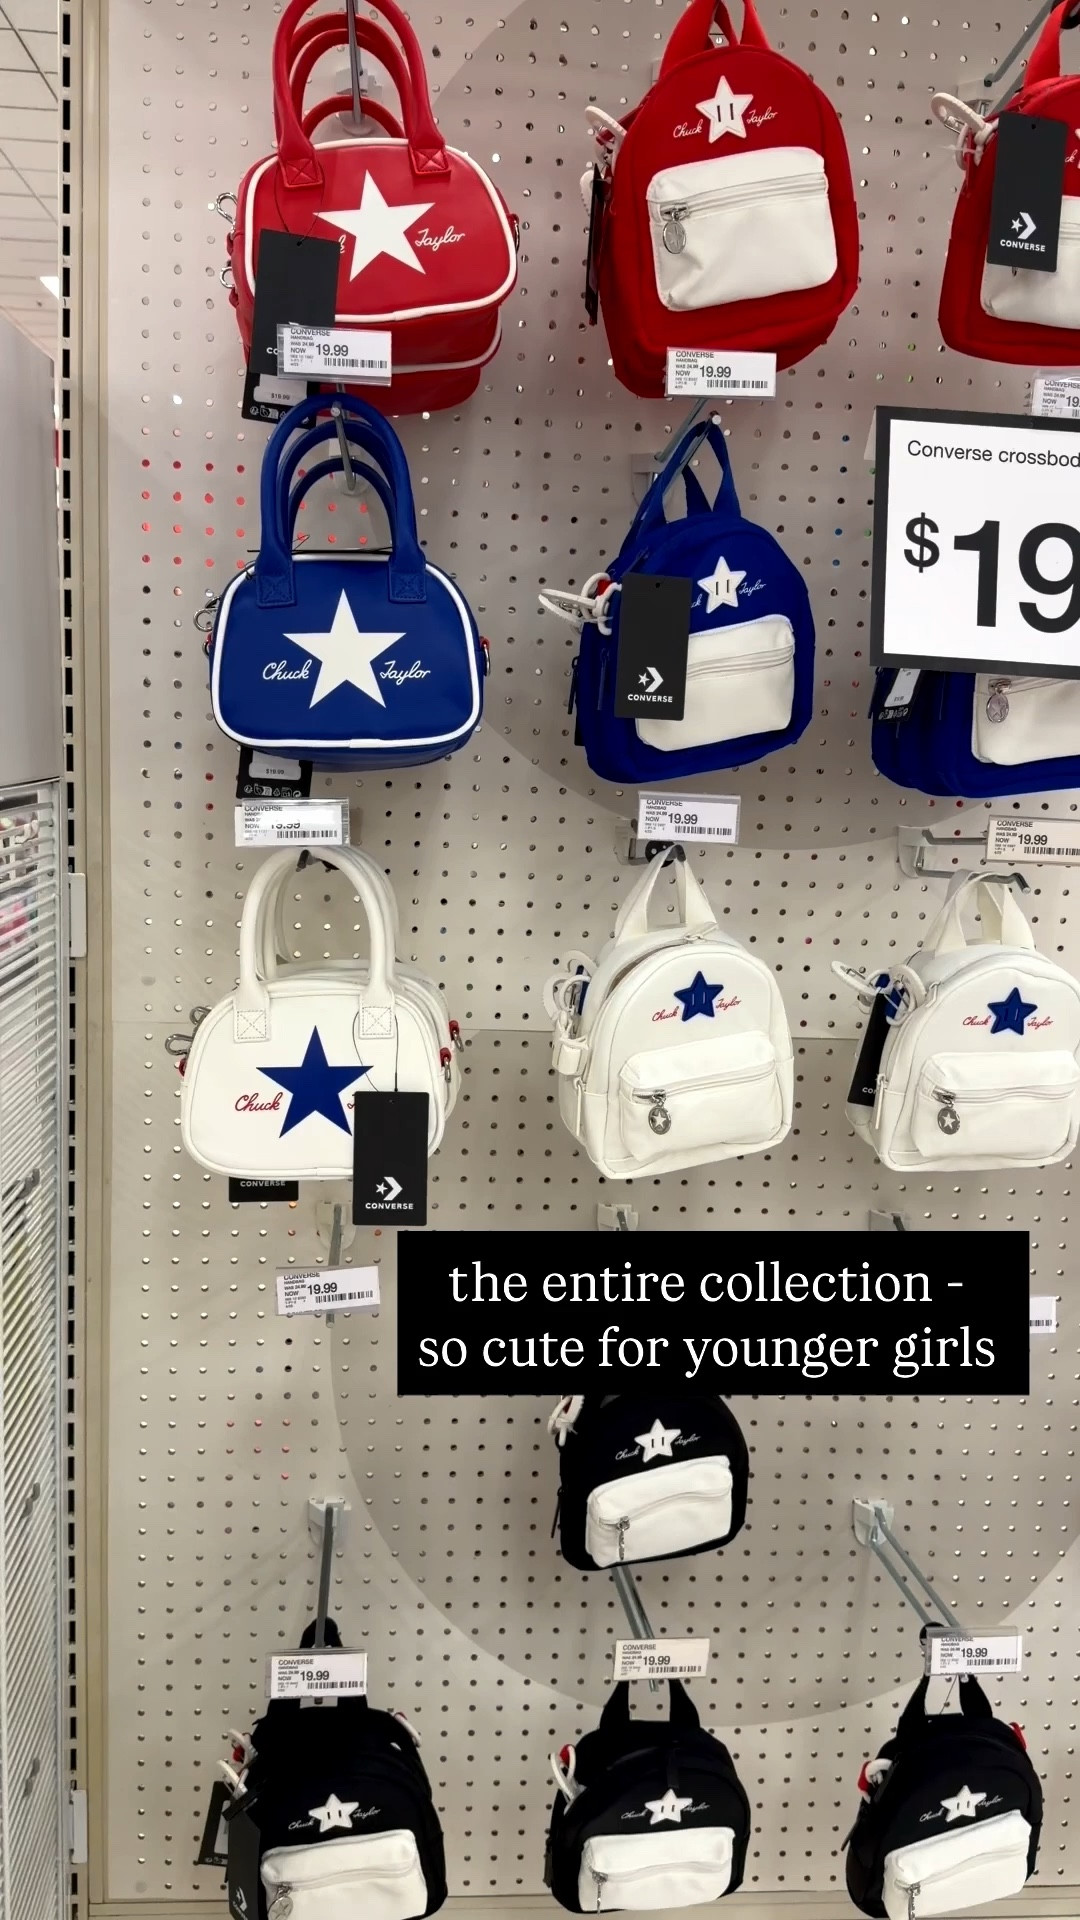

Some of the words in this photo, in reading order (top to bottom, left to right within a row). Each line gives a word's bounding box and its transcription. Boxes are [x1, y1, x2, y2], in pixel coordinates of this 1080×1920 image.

[673, 119, 704, 138] Chuck
[747, 106, 778, 127] Taylor
[415, 225, 465, 251] Taylor
[1000, 239, 1046, 252] CONVERSE
[290, 329, 331, 337] CONVERSE
[316, 344, 349, 356] 19.99
[675, 350, 715, 358] CONVERSE
[700, 365, 731, 378] 19.99
[907, 439, 993, 461] Converse
[738, 579, 767, 597] Taylor
[262, 659, 312, 680] Chuck
[379, 660, 431, 686] Taylor
[627, 693, 673, 703] CONVERSE
[646, 799, 683, 807] CONVERSE
[668, 813, 698, 825] 19.99
[997, 820, 1034, 828] CONVERSE
[1018, 834, 1048, 845] 19.99
[652, 1005, 680, 1022] Chuck
[716, 995, 742, 1011] Taylor
[962, 1015, 992, 1026] Chuck
[1027, 1016, 1053, 1030] Taylor
[234, 1092, 284, 1112] Chuck
[240, 1180, 286, 1188] CONVERSE
[365, 1202, 414, 1210] CONVERSE
[283, 1271, 320, 1280] CONVERSE
[307, 1282, 337, 1295] 19.99
[615, 1445, 640, 1460] Chuck
[961, 1647, 988, 1658] 19.99
[643, 1655, 671, 1666] 19.99
[300, 1670, 330, 1681] 19.99
